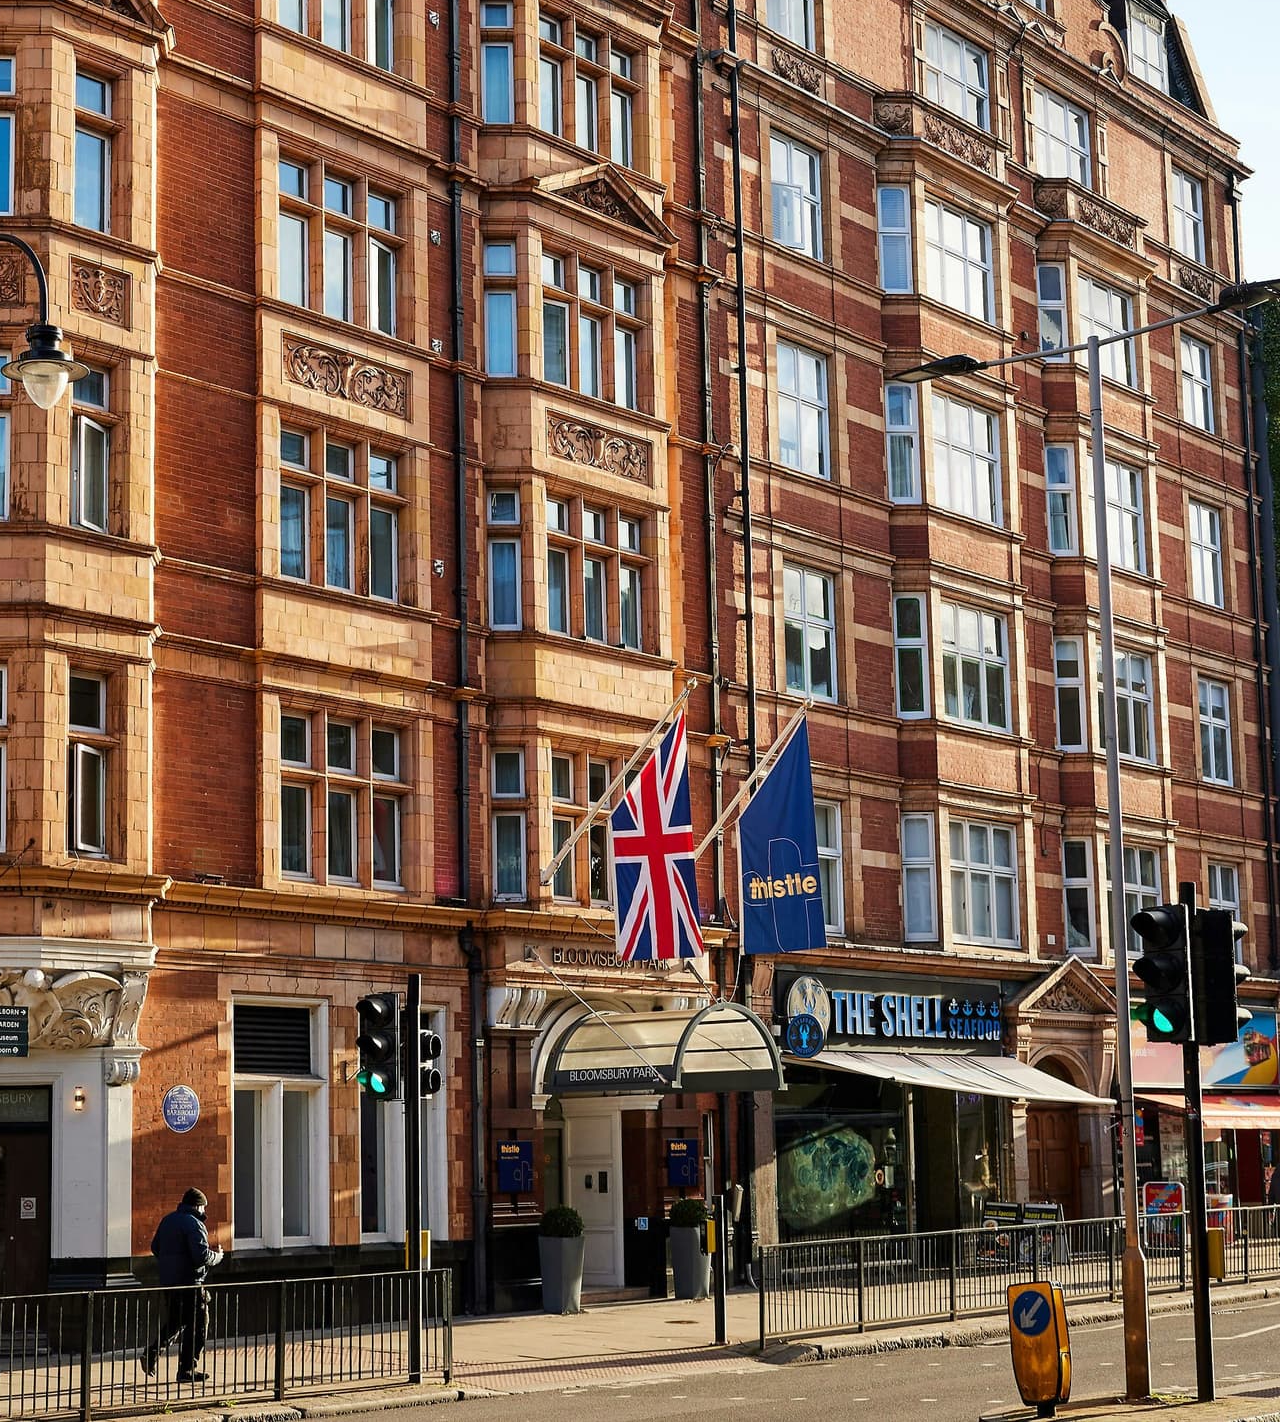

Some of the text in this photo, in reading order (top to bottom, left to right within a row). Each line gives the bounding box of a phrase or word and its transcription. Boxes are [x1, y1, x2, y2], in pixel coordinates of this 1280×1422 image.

[749, 872, 817, 899] thistle
[831, 990, 947, 1039] THE SHELL
[949, 1018, 1001, 1041] SEAFOOD
[569, 1067, 657, 1081] BLOOMSBURY PARK
